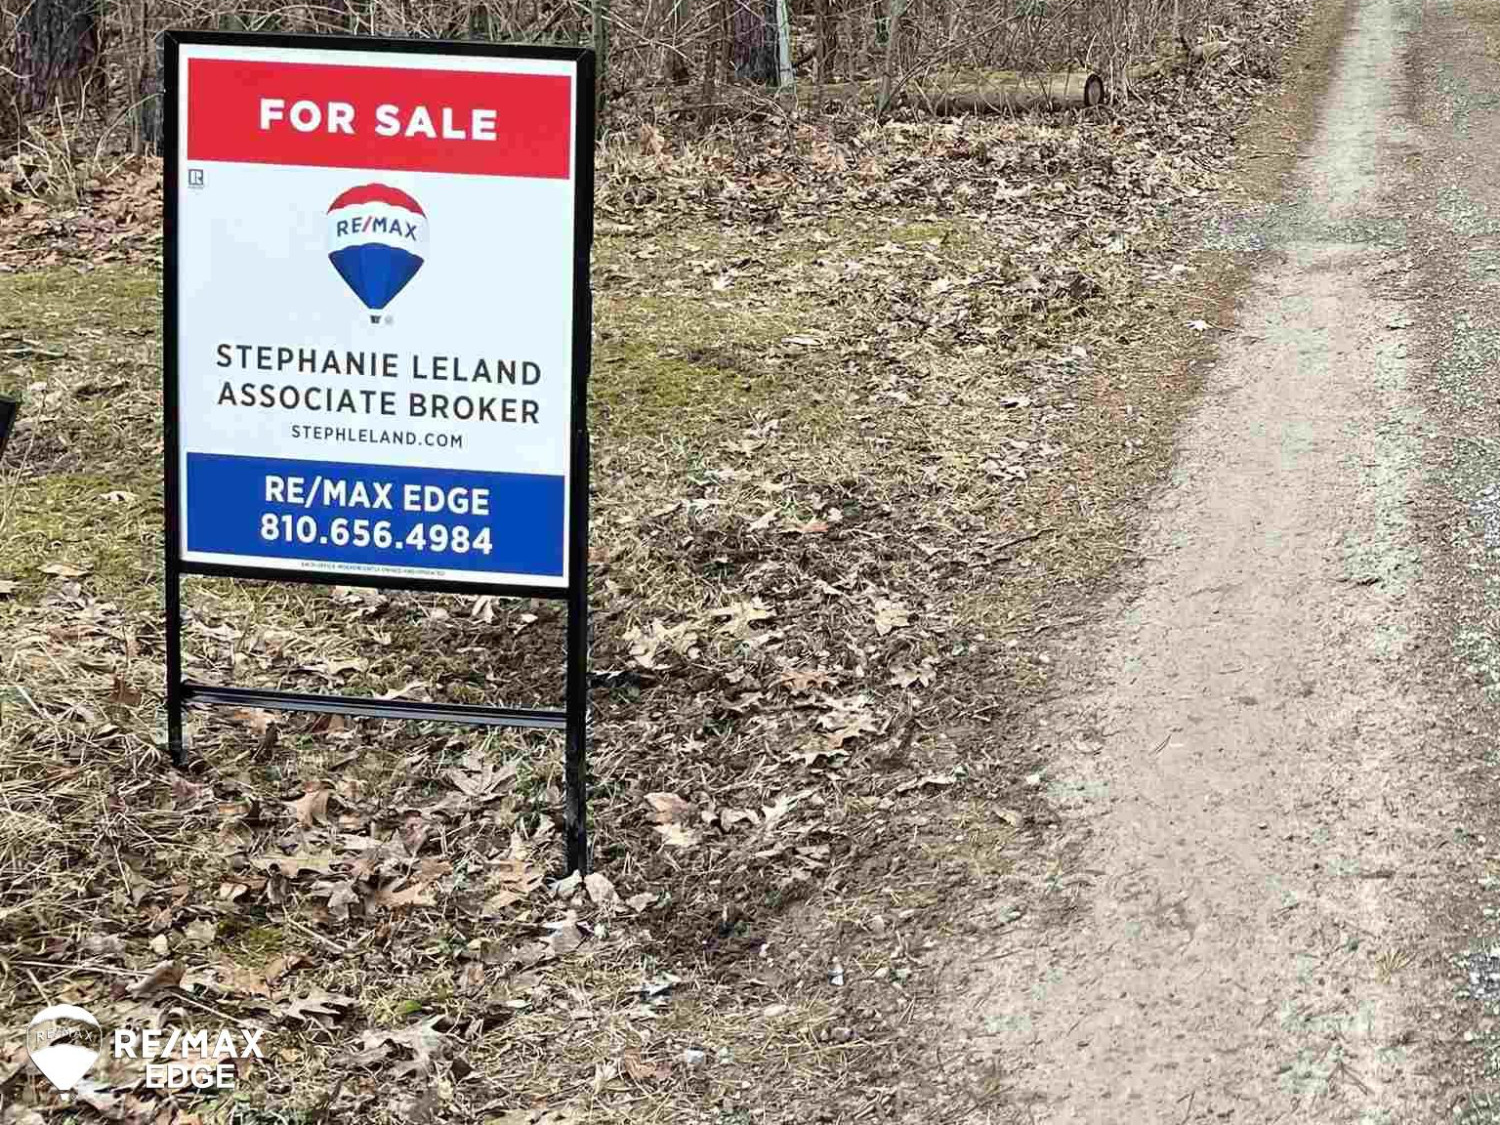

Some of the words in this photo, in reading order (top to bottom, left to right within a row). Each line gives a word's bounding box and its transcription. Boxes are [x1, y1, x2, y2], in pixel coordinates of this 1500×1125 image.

[259, 98, 356, 134] FOR
[374, 104, 498, 141] SALE
[336, 215, 418, 241] RE/MAX
[216, 343, 399, 377] STEPHANIE
[413, 354, 542, 386] LELAND
[217, 381, 397, 415] ASSOCIATE
[409, 393, 541, 424] BROKER
[291, 424, 463, 449] STEPHLELAND.COM
[264, 475, 393, 510] RE/MAX
[403, 484, 491, 516] EDGE
[259, 513, 493, 555] 810.656.4984
